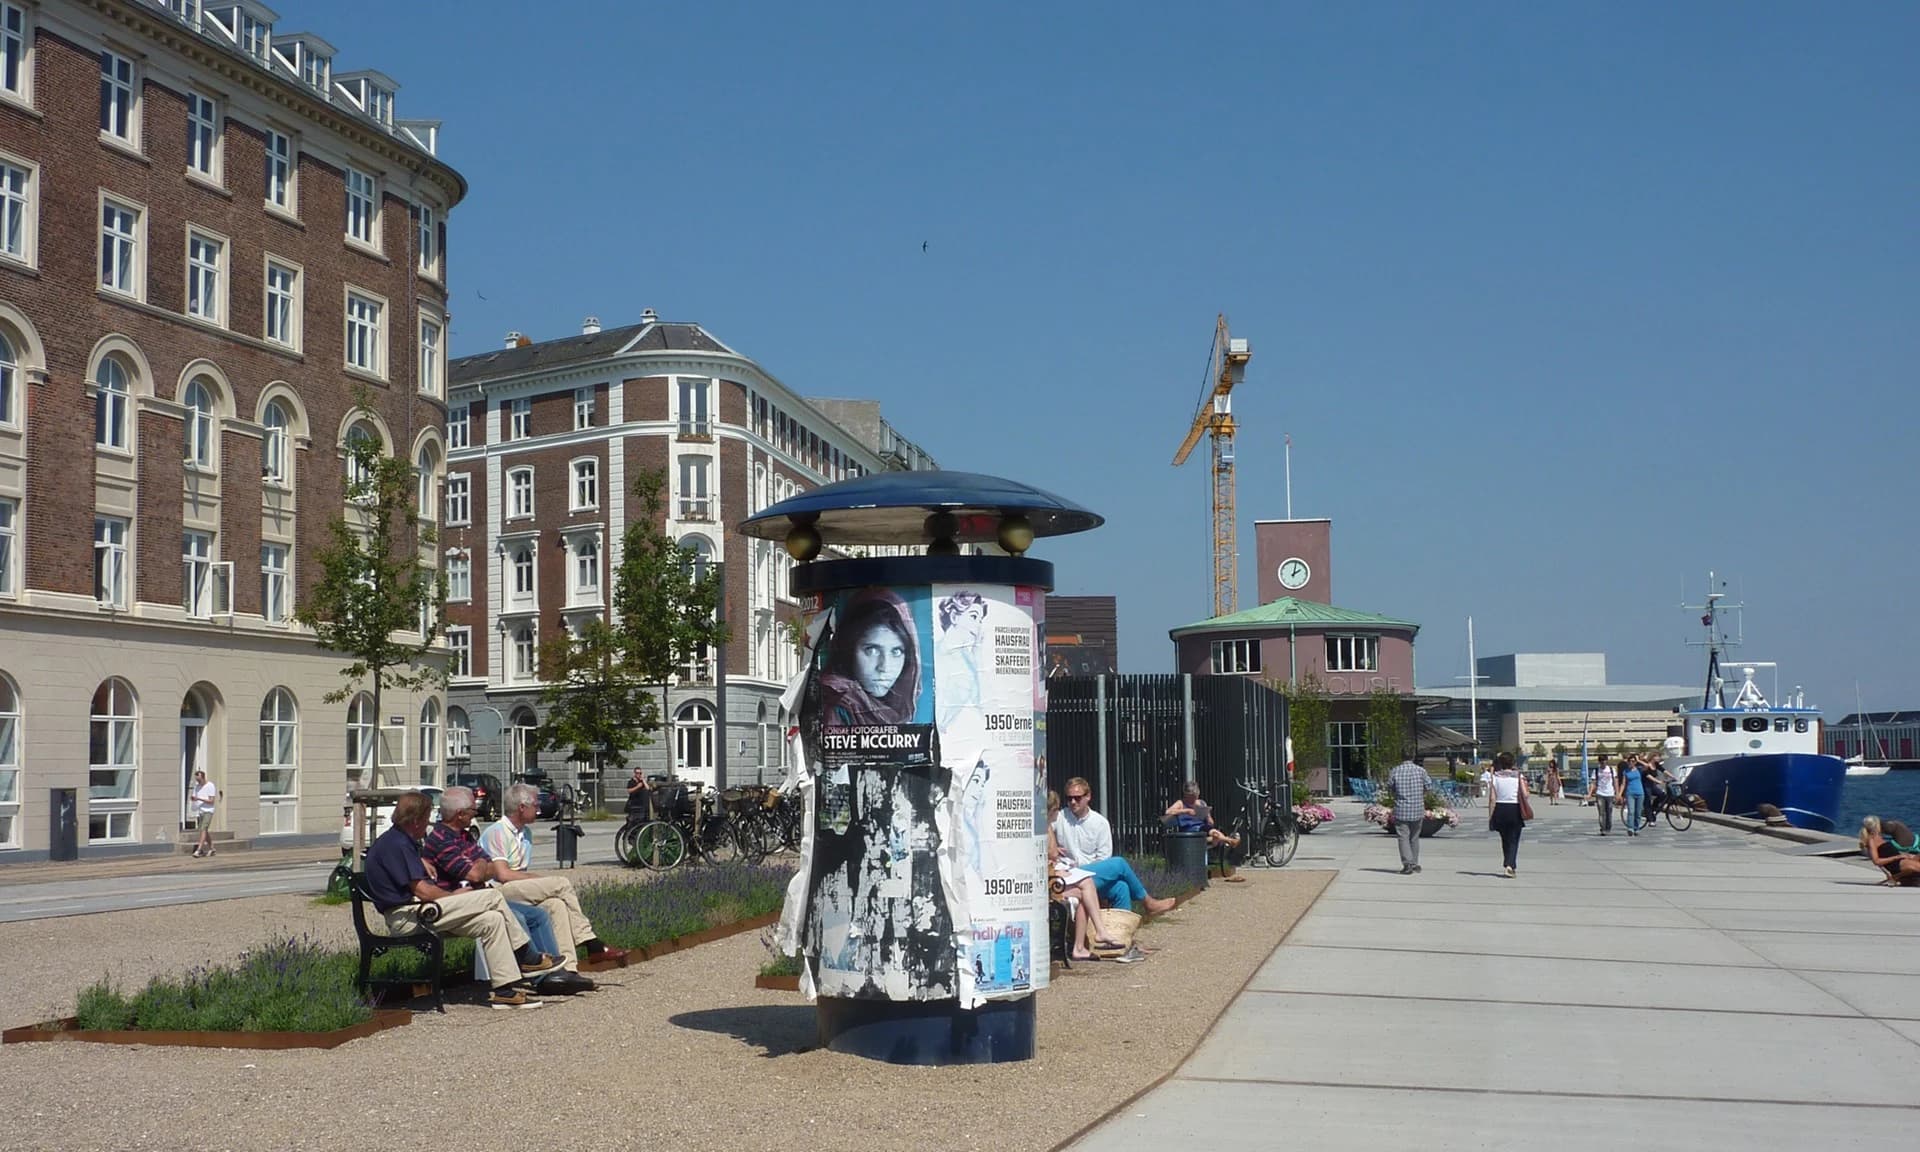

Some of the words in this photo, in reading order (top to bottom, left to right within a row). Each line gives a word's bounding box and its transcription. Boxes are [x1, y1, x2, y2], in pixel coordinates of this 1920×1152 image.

[995, 635, 1030, 647] HAUSFRAU
[995, 656, 1031, 667] SKAFFEDYR
[985, 714, 1032, 730] 1950'erne
[851, 725, 899, 735] FOTOGRAFIER
[824, 735, 857, 749] STEVE
[861, 733, 921, 748] MCCURRY
[996, 799, 1032, 810] HAUSFRAU
[996, 819, 1032, 830] SKAFFEDYR
[985, 879, 1033, 895] 1950'erne
[1005, 925, 1024, 938] Fire
